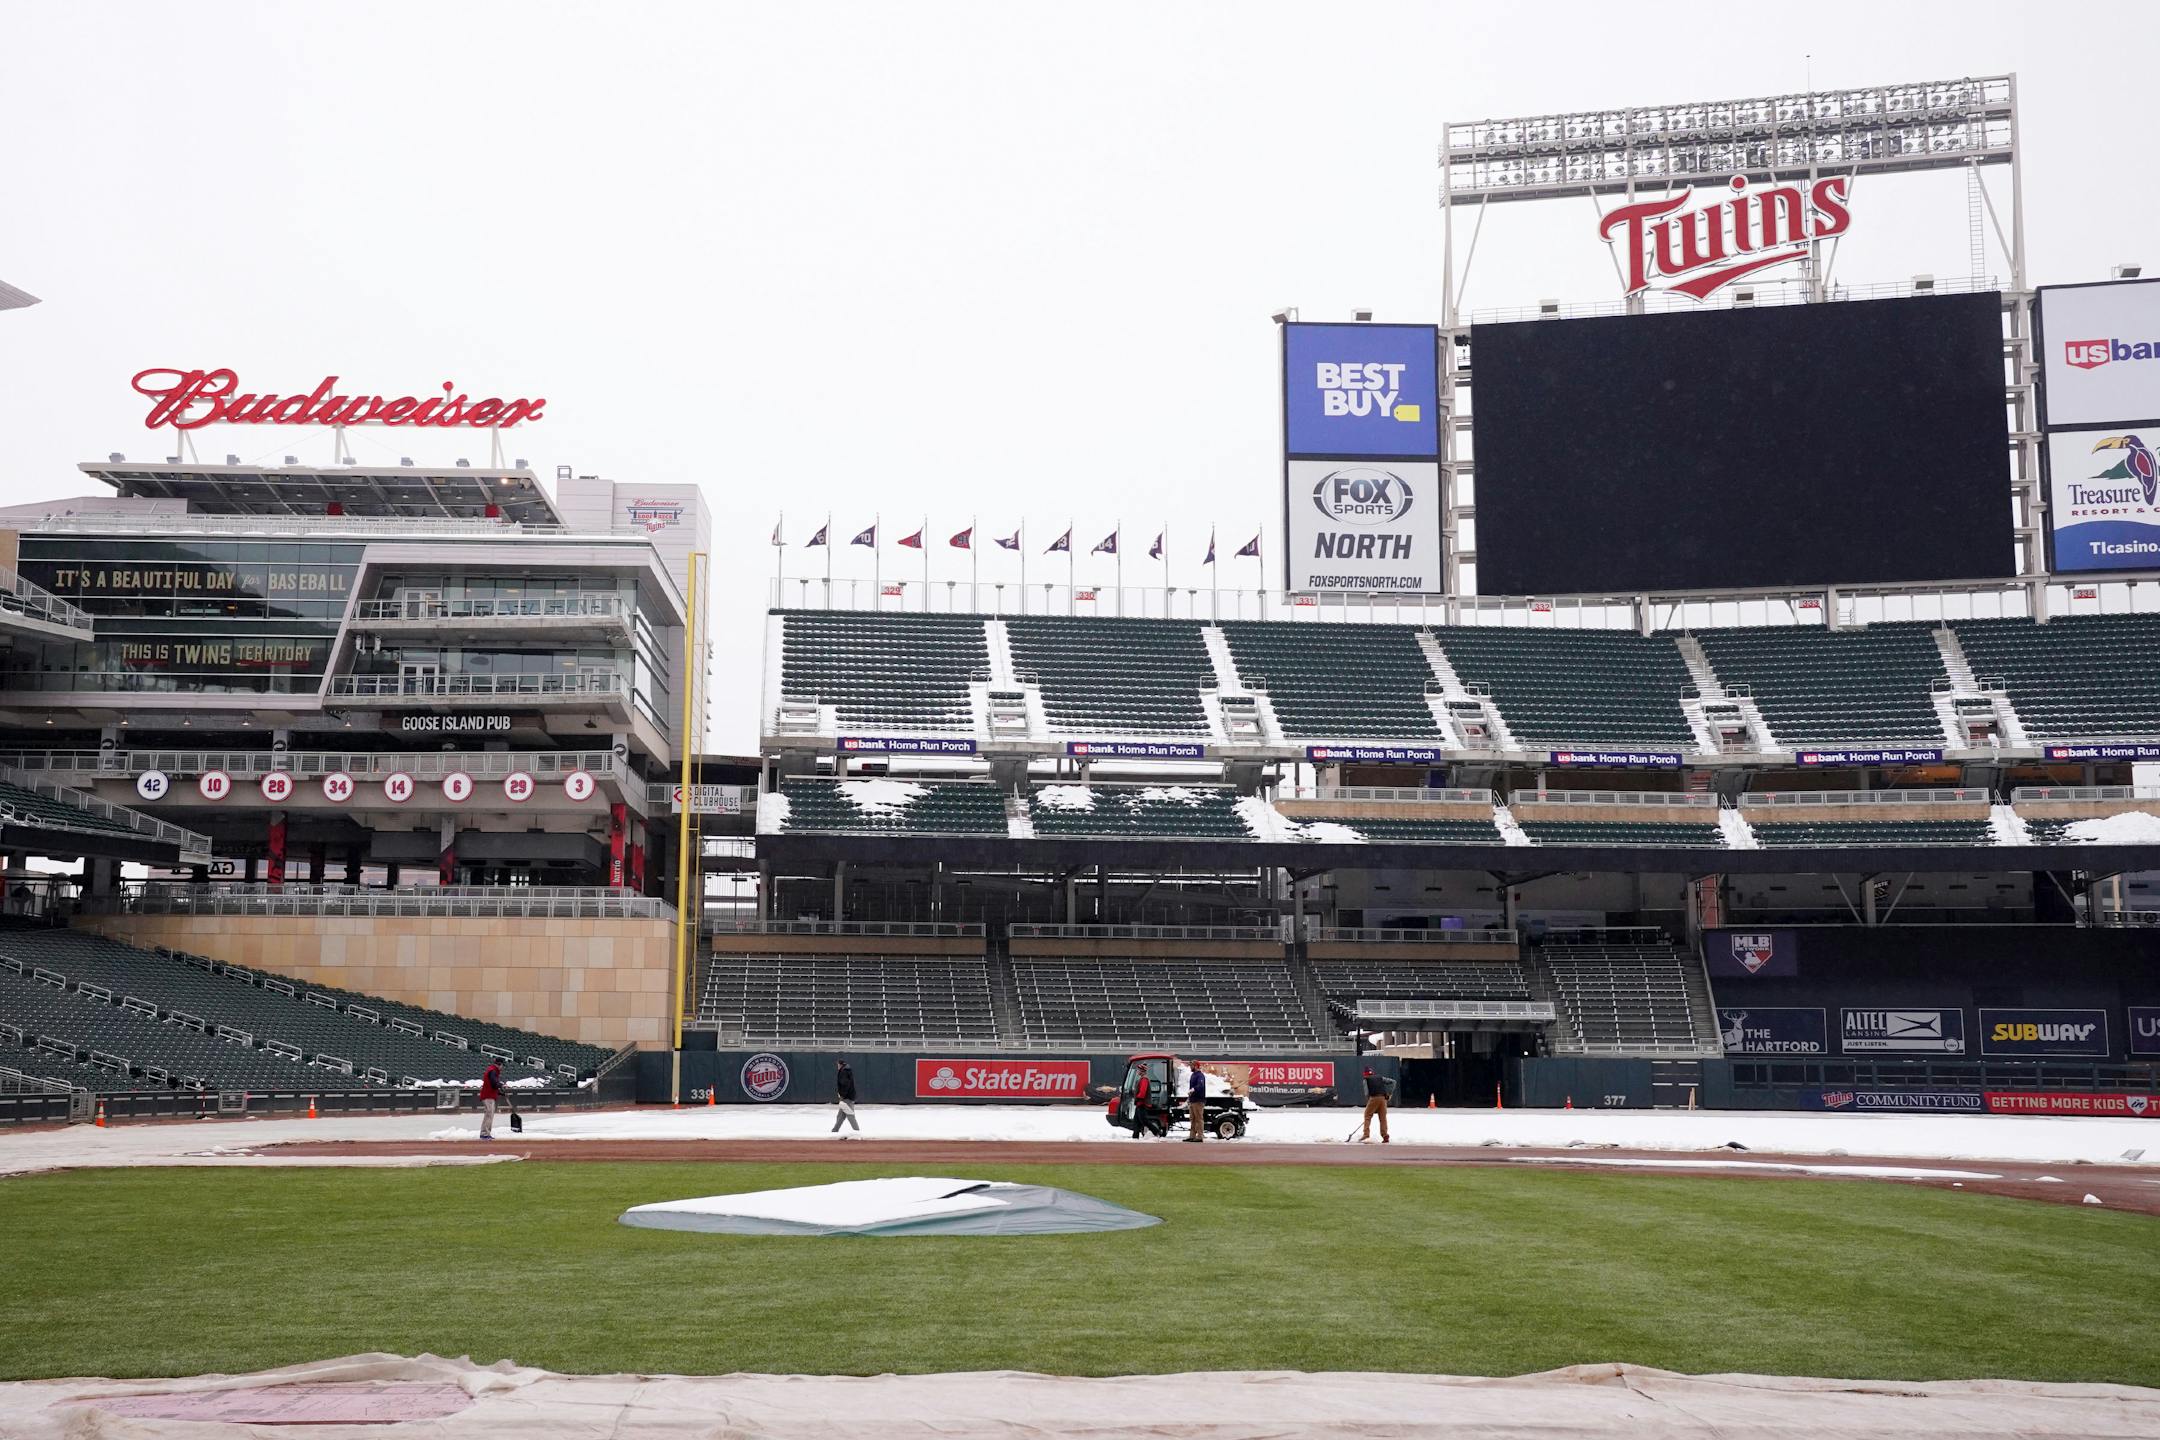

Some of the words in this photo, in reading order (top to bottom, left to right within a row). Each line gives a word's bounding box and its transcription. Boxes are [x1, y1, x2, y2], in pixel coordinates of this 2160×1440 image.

[1599, 173, 1852, 300] Twins
[1316, 362, 1405, 390] BEST
[131, 368, 547, 429] Budweiser
[1324, 391, 1398, 417] BUY
[1334, 478, 1392, 504] FOX
[2067, 484, 2141, 505] Treasure
[1334, 504, 1394, 515] SPORTS
[2072, 508, 2128, 516] RESORT
[1314, 532, 1412, 559] NORTH
[56, 570, 91, 588] IT'S
[96, 570, 106, 588] A
[112, 571, 202, 589] BEAUTIFUL
[206, 572, 235, 589] DAY
[241, 574, 261, 589] for
[268, 573, 346, 591] BASEBALL
[1309, 575, 1422, 588] FOXSPORTSNORTH.COM
[885, 586, 901, 594] 329
[1079, 591, 1095, 599] 330
[1299, 597, 1314, 605] 331
[122, 643, 151, 659] THIS
[155, 643, 169, 659] IS
[174, 644, 231, 664] TWINS
[238, 646, 312, 661] TERRITORY
[402, 716, 440, 730] GOOSE
[442, 716, 484, 730] ISLAND
[486, 715, 511, 730] PUB
[889, 741, 918, 750] Home
[920, 741, 939, 750] Run
[942, 742, 970, 751] Porch
[1117, 745, 1146, 754] Home
[1148, 746, 1167, 755] Run
[1170, 746, 1198, 755] Porch
[2102, 747, 2134, 756] Home
[2137, 746, 2160, 756] Run
[1356, 750, 1384, 758] Home
[1386, 750, 1405, 759] Run
[1407, 750, 1435, 759] Porch
[1600, 754, 1627, 763] Home
[1629, 755, 1648, 763] Run
[1650, 755, 1677, 764] Porch
[1849, 753, 1880, 761] Home
[1882, 752, 1903, 760] Run
[1905, 751, 1936, 760] Porch
[144, 778, 161, 792] 42
[207, 778, 222, 792] 10
[268, 779, 285, 793] 28
[329, 780, 347, 794] 34
[391, 780, 405, 794] 14
[453, 779, 462, 794] 6
[510, 779, 527, 794] 29
[575, 779, 584, 793] 3
[694, 786, 725, 797] DIGITAL
[693, 796, 739, 806] CLUBHOUSE
[612, 860, 621, 883] barrio
[1734, 936, 1770, 947] MLB
[1846, 1012, 1886, 1030] ALTEC
[1746, 1028, 1771, 1038] THE
[1991, 1023, 2096, 1042] SUBWAY
[1746, 1041, 1820, 1052] HARTFORD
[747, 1067, 784, 1087] Twins
[1258, 1067, 1285, 1080] THIS
[1288, 1067, 1323, 1080] BUD'S
[1604, 1095, 1626, 1106] 377
[1822, 1091, 1854, 1108] Twins
[1856, 1094, 1943, 1107] COMMUNITY
[1944, 1096, 1981, 1107] FUND
[1991, 1096, 2048, 1108] GETTING
[2051, 1097, 2090, 1109] MORE
[2094, 1098, 2125, 1110] KIDS
[2130, 1098, 2145, 1109] in
